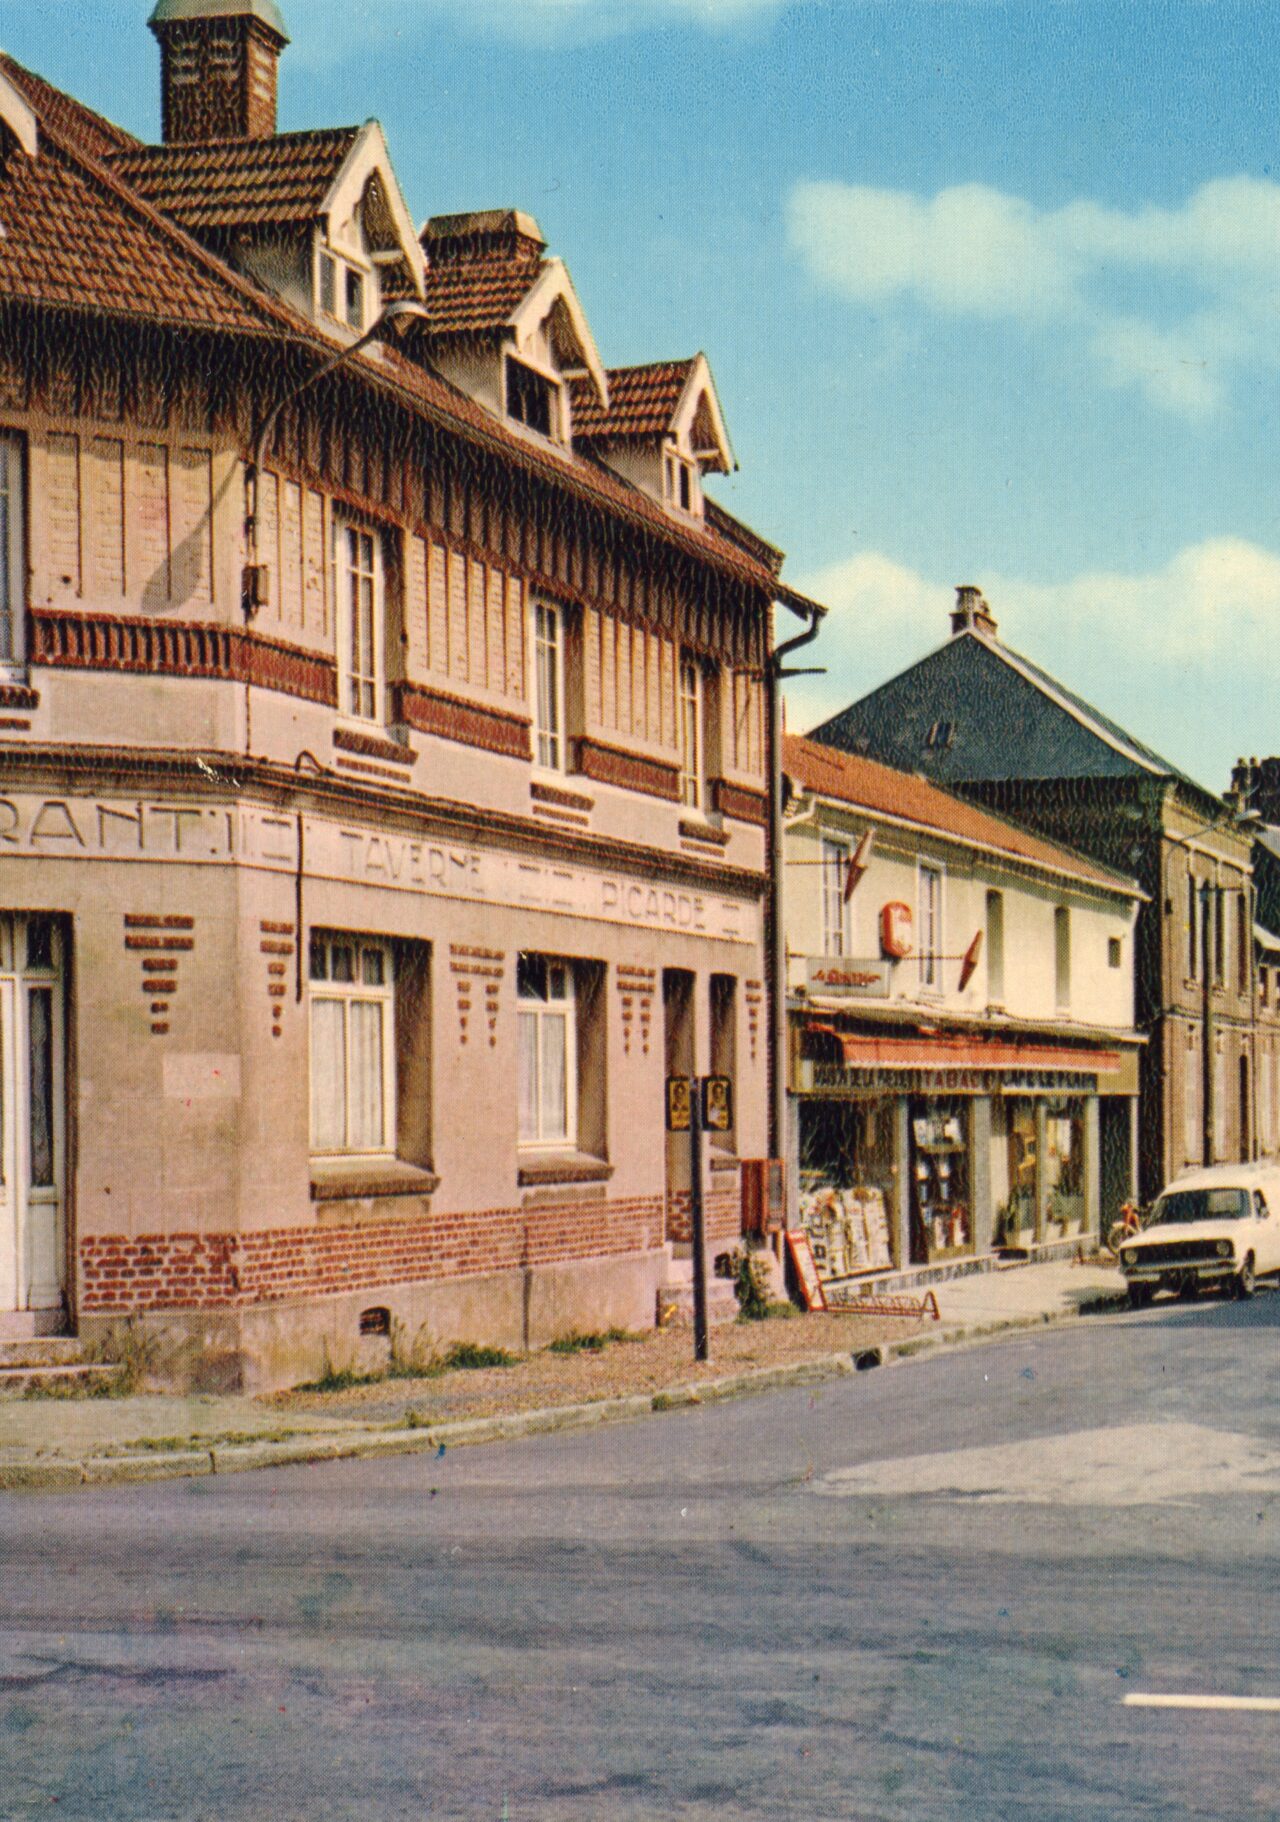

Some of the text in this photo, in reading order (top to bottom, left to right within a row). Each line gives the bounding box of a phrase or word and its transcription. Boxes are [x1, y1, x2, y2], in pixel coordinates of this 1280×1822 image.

[340, 831, 706, 931] TAVERNE PICARDE
[924, 1069, 980, 1089] TABAC
